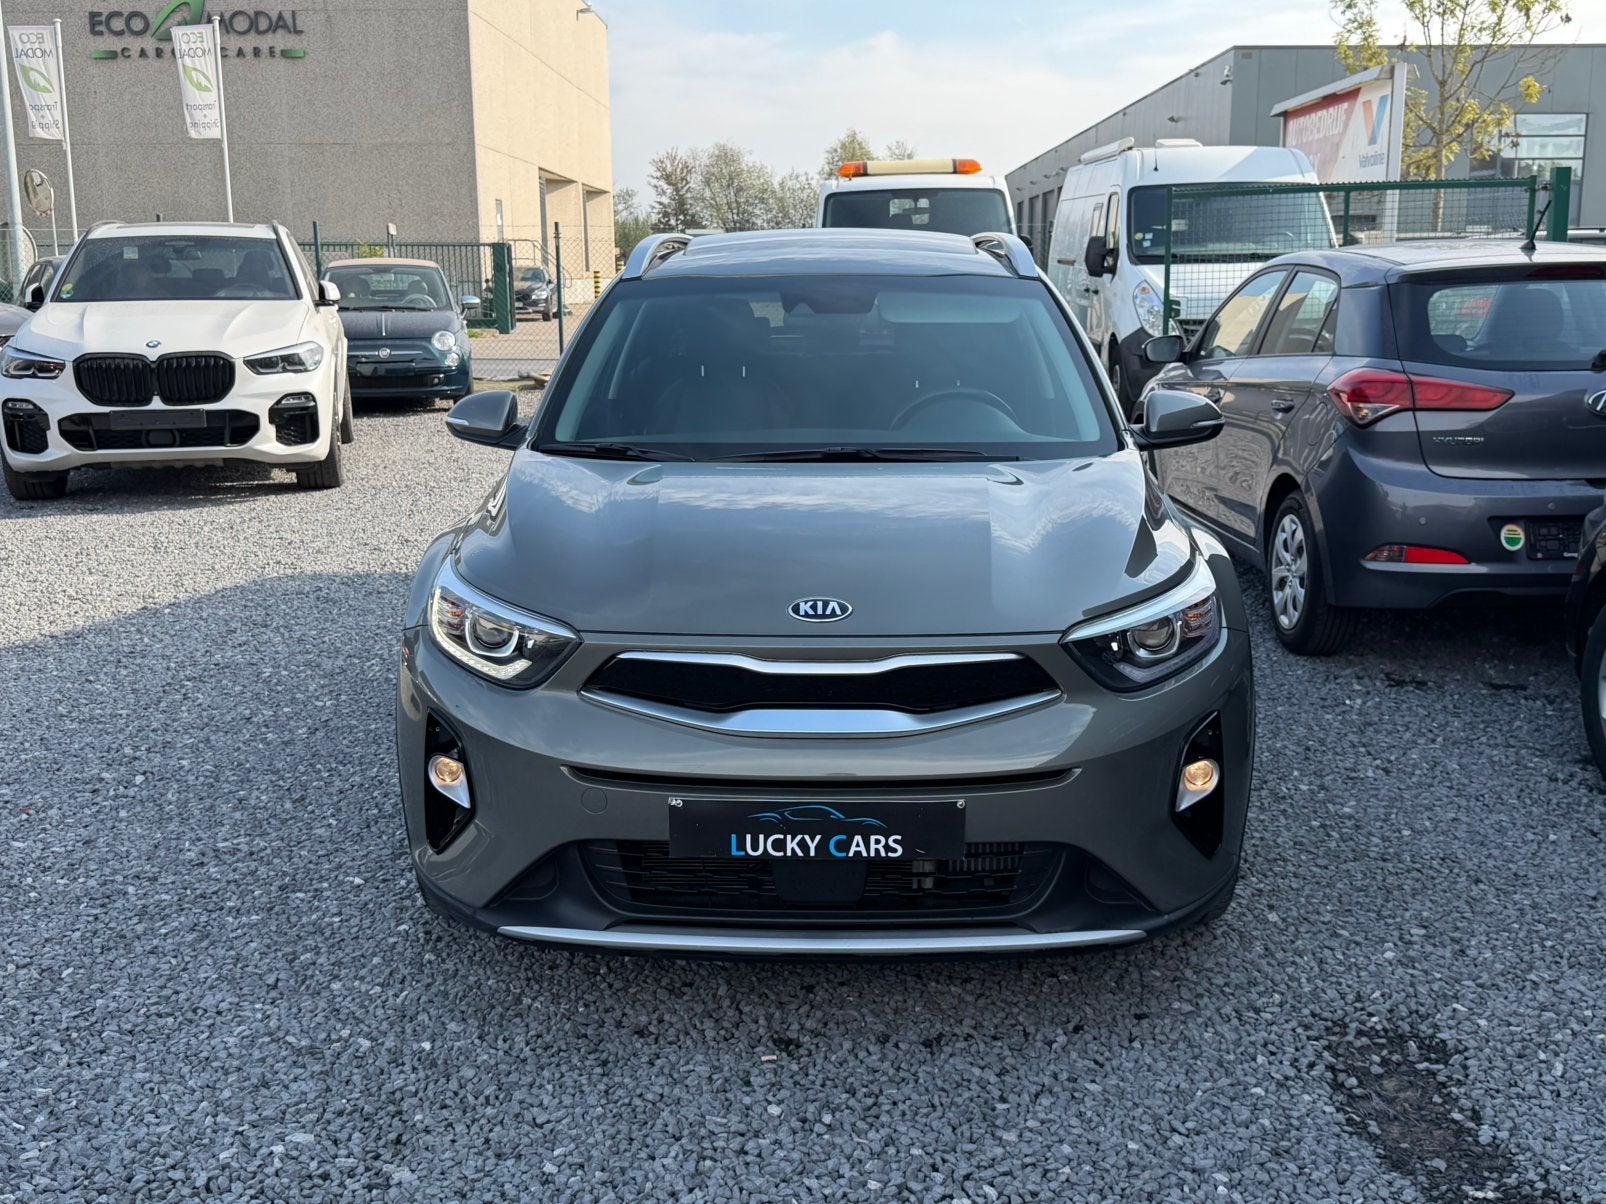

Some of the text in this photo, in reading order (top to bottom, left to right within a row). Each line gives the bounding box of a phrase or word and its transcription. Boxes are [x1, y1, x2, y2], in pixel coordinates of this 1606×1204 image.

[88, 10, 305, 36] ECO MODAL
[120, 46, 276, 59] CAR CARE
[799, 601, 842, 615] KIA
[731, 833, 903, 857] LUCKY CARS
